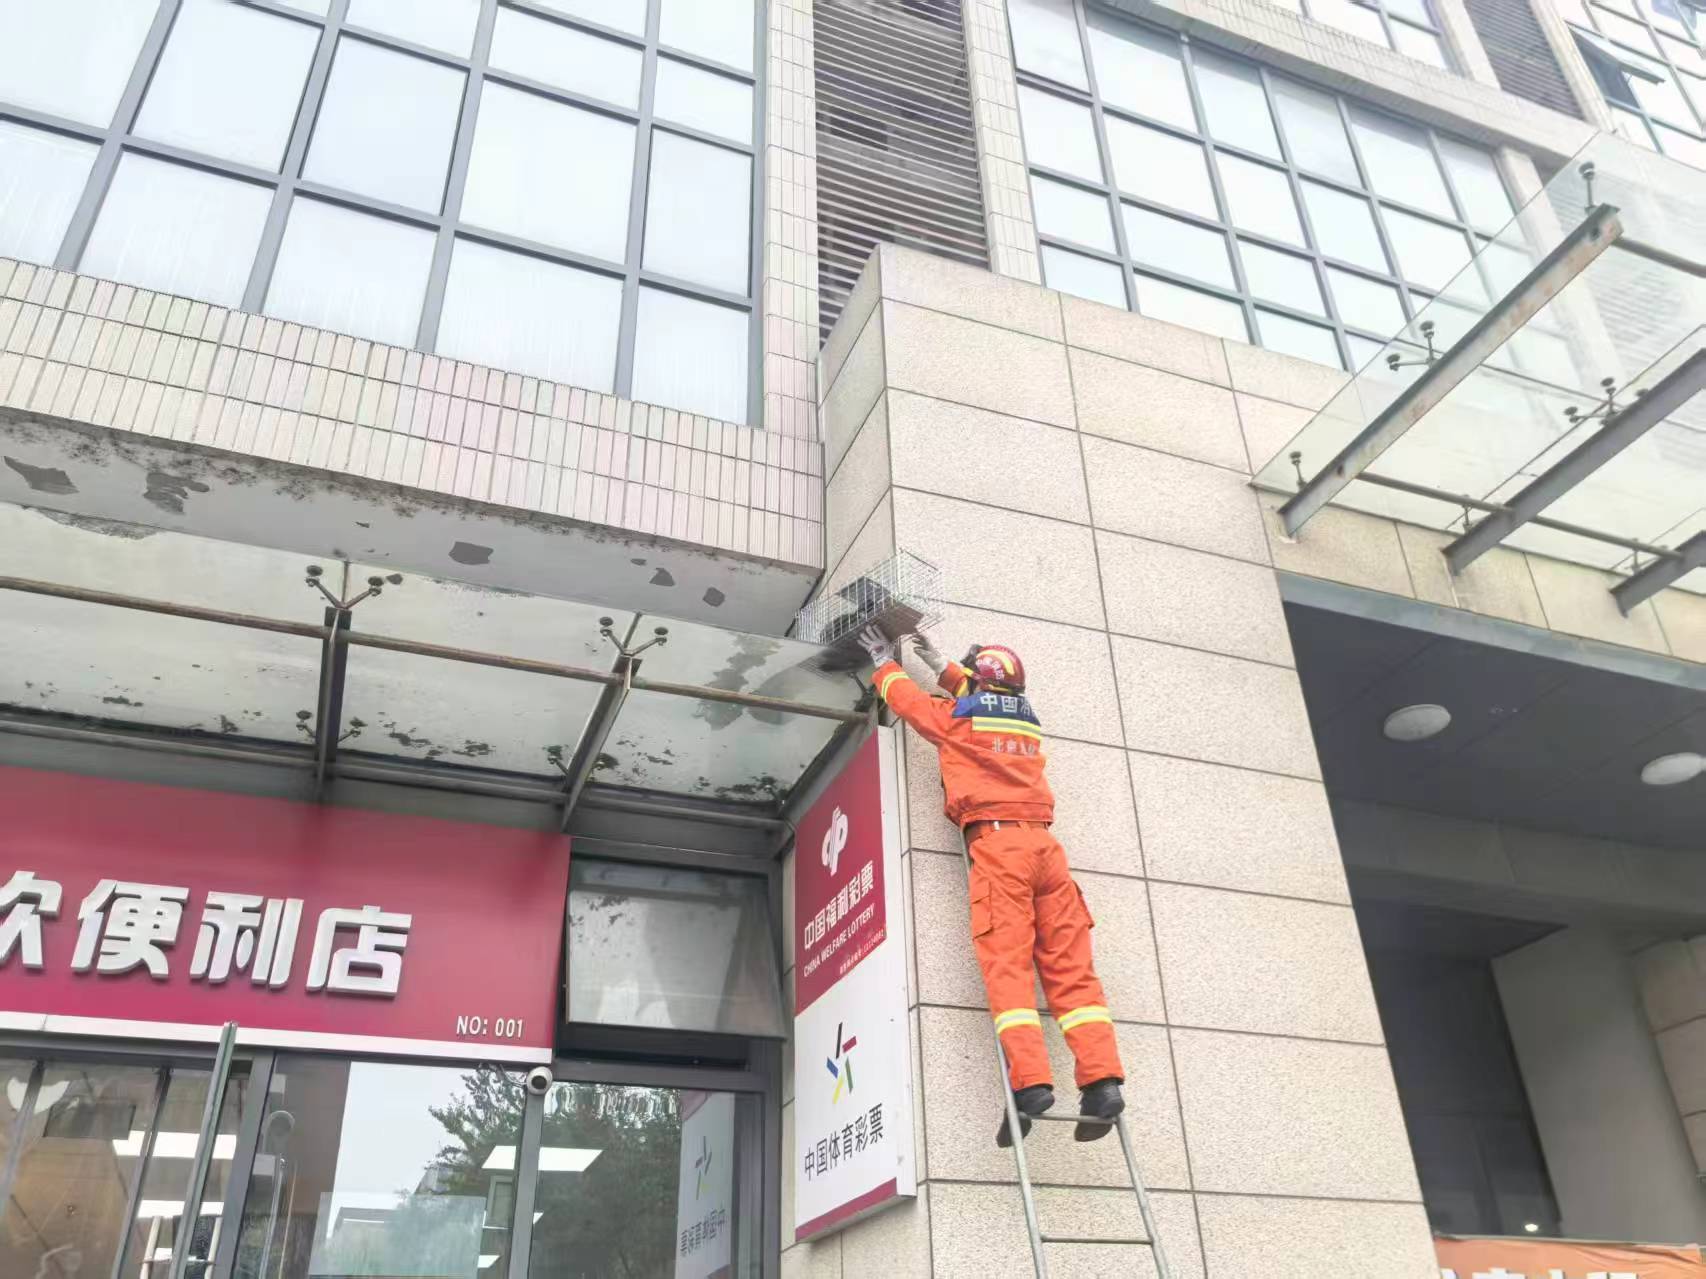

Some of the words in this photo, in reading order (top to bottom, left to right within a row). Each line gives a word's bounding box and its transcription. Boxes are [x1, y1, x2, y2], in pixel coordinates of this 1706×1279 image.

[803, 859, 874, 951] 中国福利彩票
[803, 955, 821, 978] CHINA
[820, 929, 848, 962] WELFARE
[847, 902, 875, 939] LOTTERY
[456, 1015, 488, 1035] NO:
[494, 1017, 523, 1038] 001
[804, 1103, 884, 1181] 中国体育彩票
